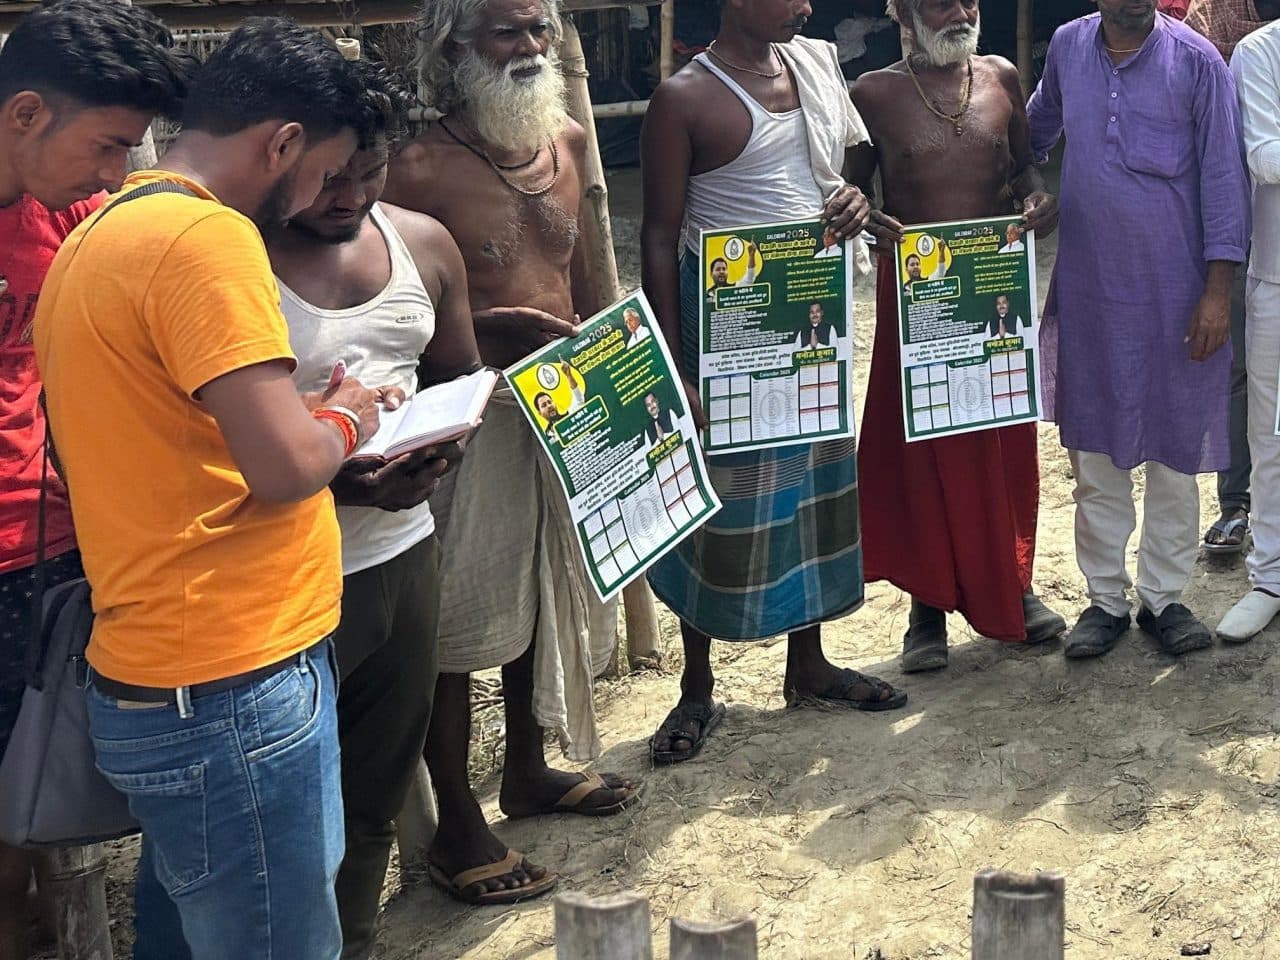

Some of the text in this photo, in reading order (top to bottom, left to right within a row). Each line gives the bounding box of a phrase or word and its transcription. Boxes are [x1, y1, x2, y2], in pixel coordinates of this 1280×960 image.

[785, 228, 810, 239] 2025
[972, 226, 994, 236] 2025
[589, 322, 612, 342] 2025
